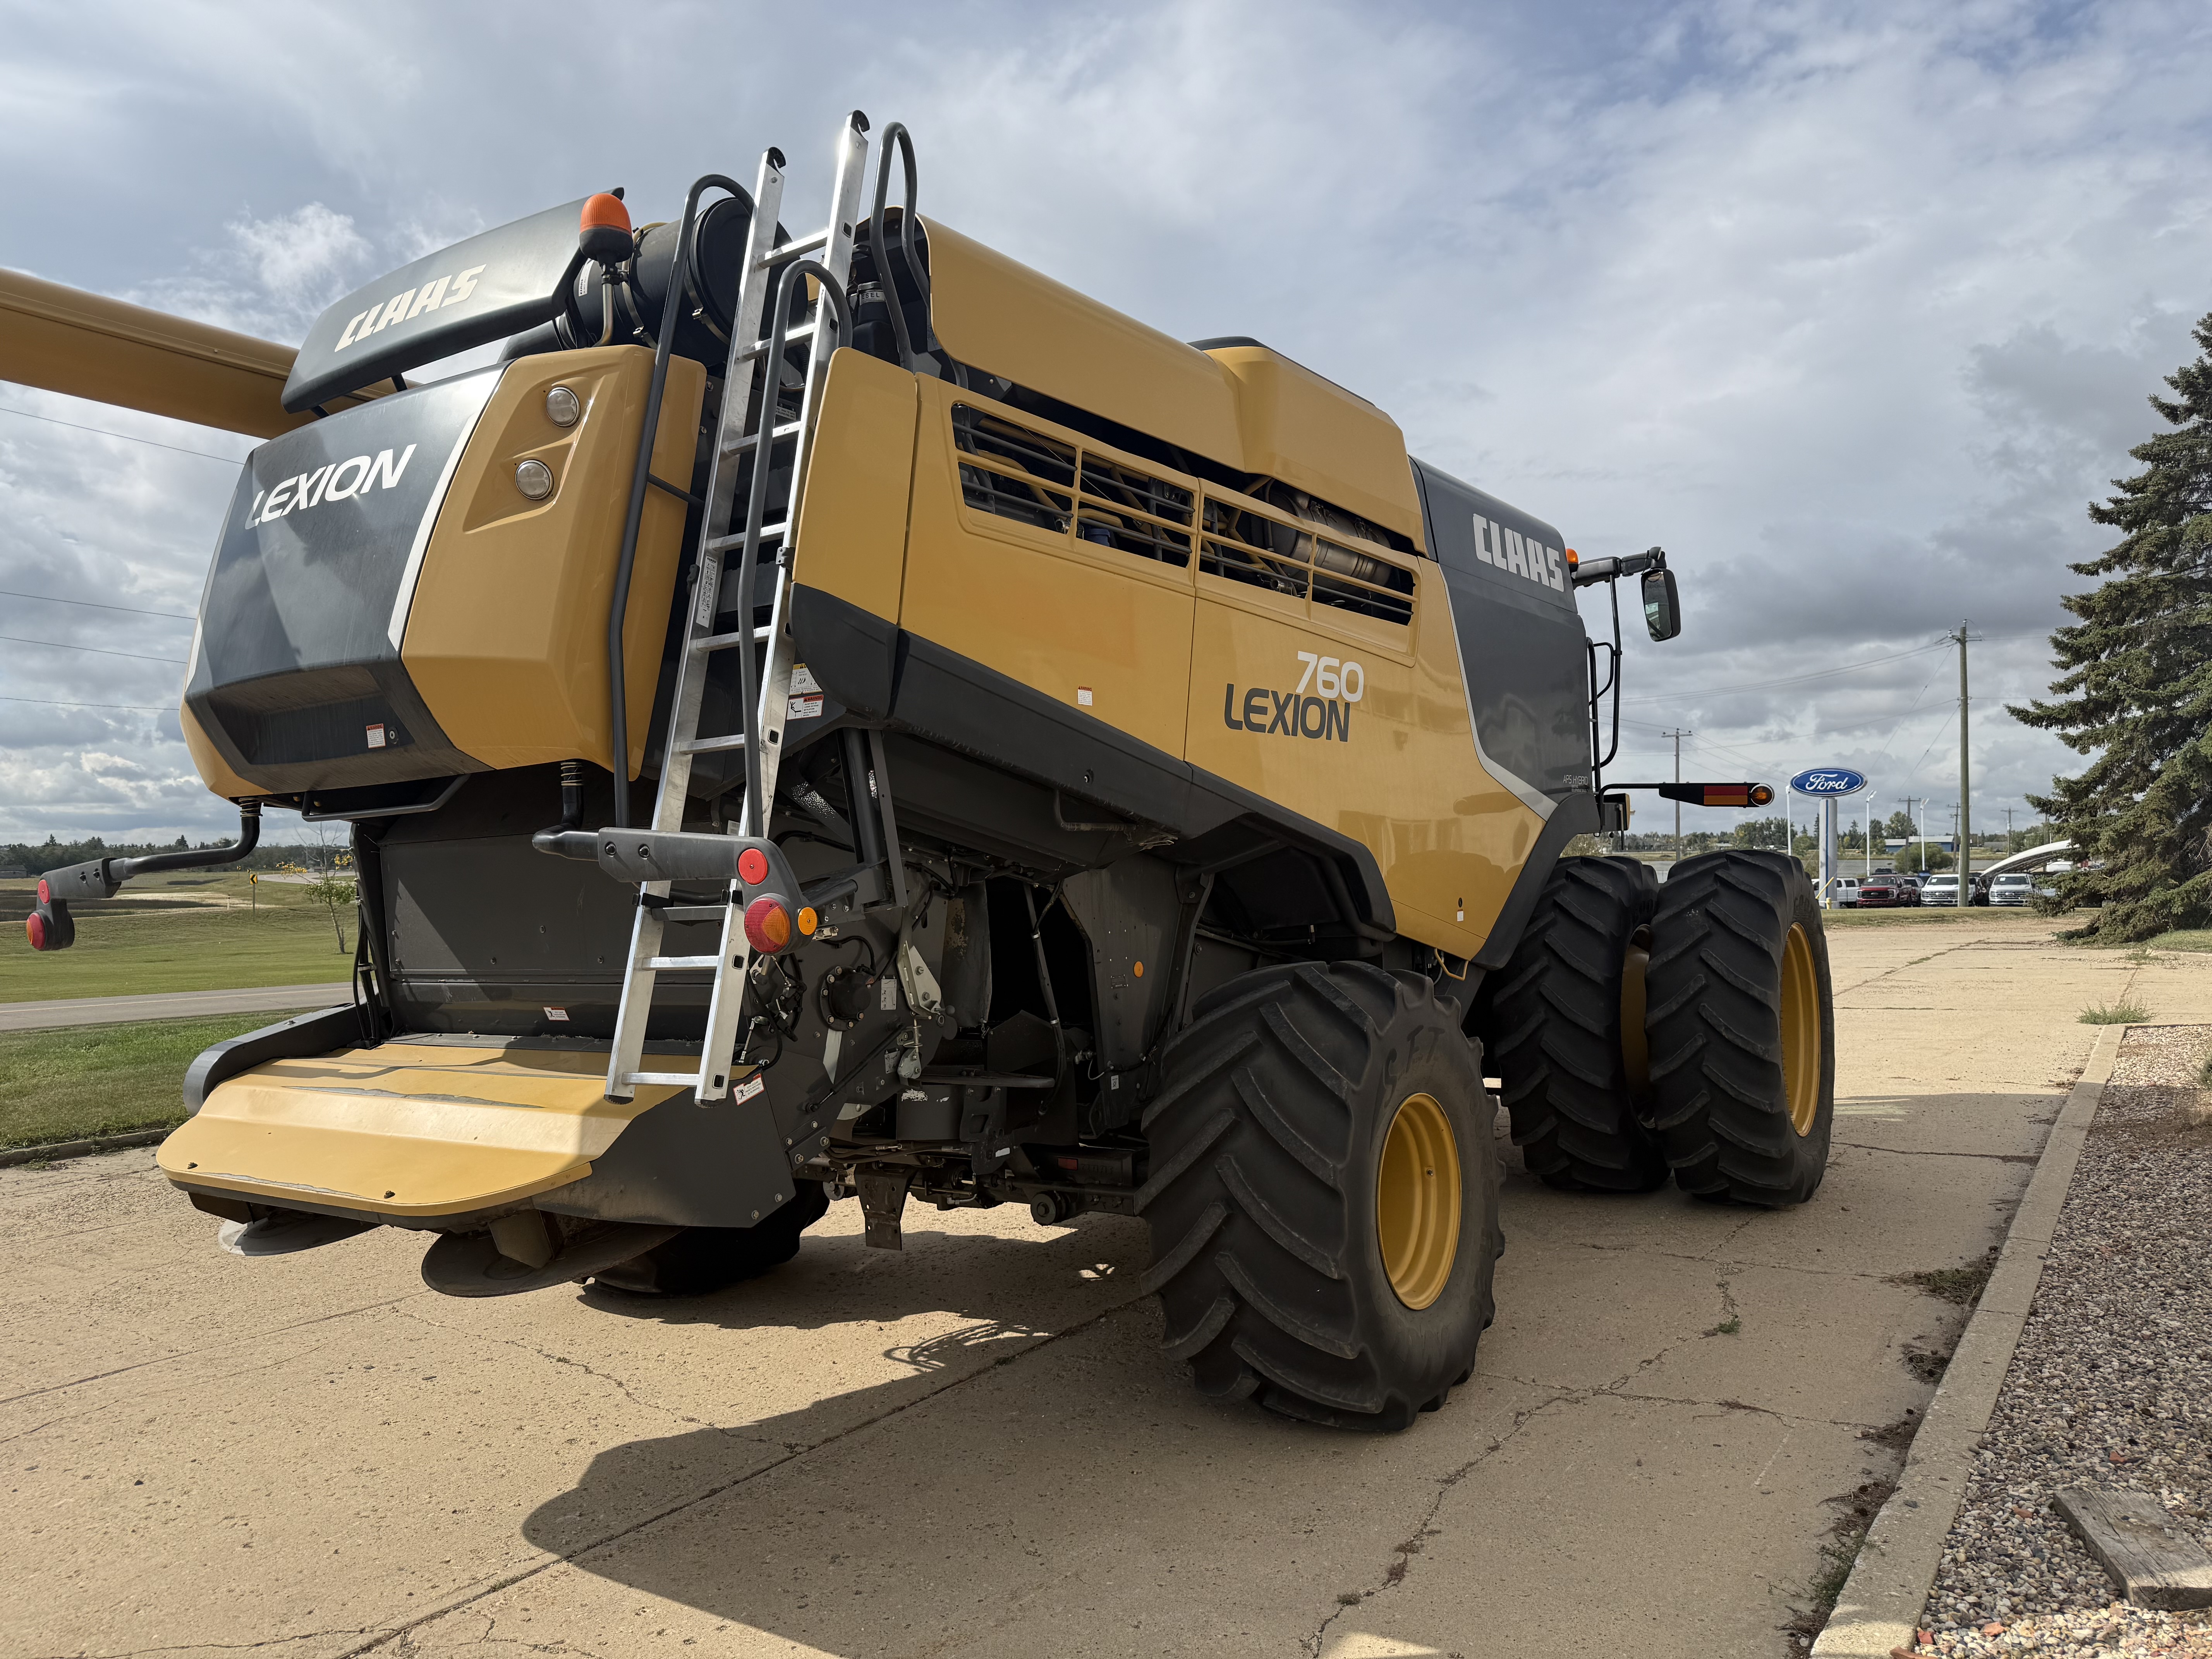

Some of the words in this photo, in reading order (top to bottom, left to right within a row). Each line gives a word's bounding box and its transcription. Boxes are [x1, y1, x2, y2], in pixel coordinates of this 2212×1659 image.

[335, 264, 487, 353] CLAAS
[245, 444, 417, 530] LEXION
[1473, 513, 1564, 592] CLAAS
[1295, 651, 1364, 702] 760
[1224, 683, 1351, 742] LEXION
[1563, 775, 1571, 783] APS
[1573, 776, 1588, 785] HYBRID
[1805, 773, 1848, 791] Ford
